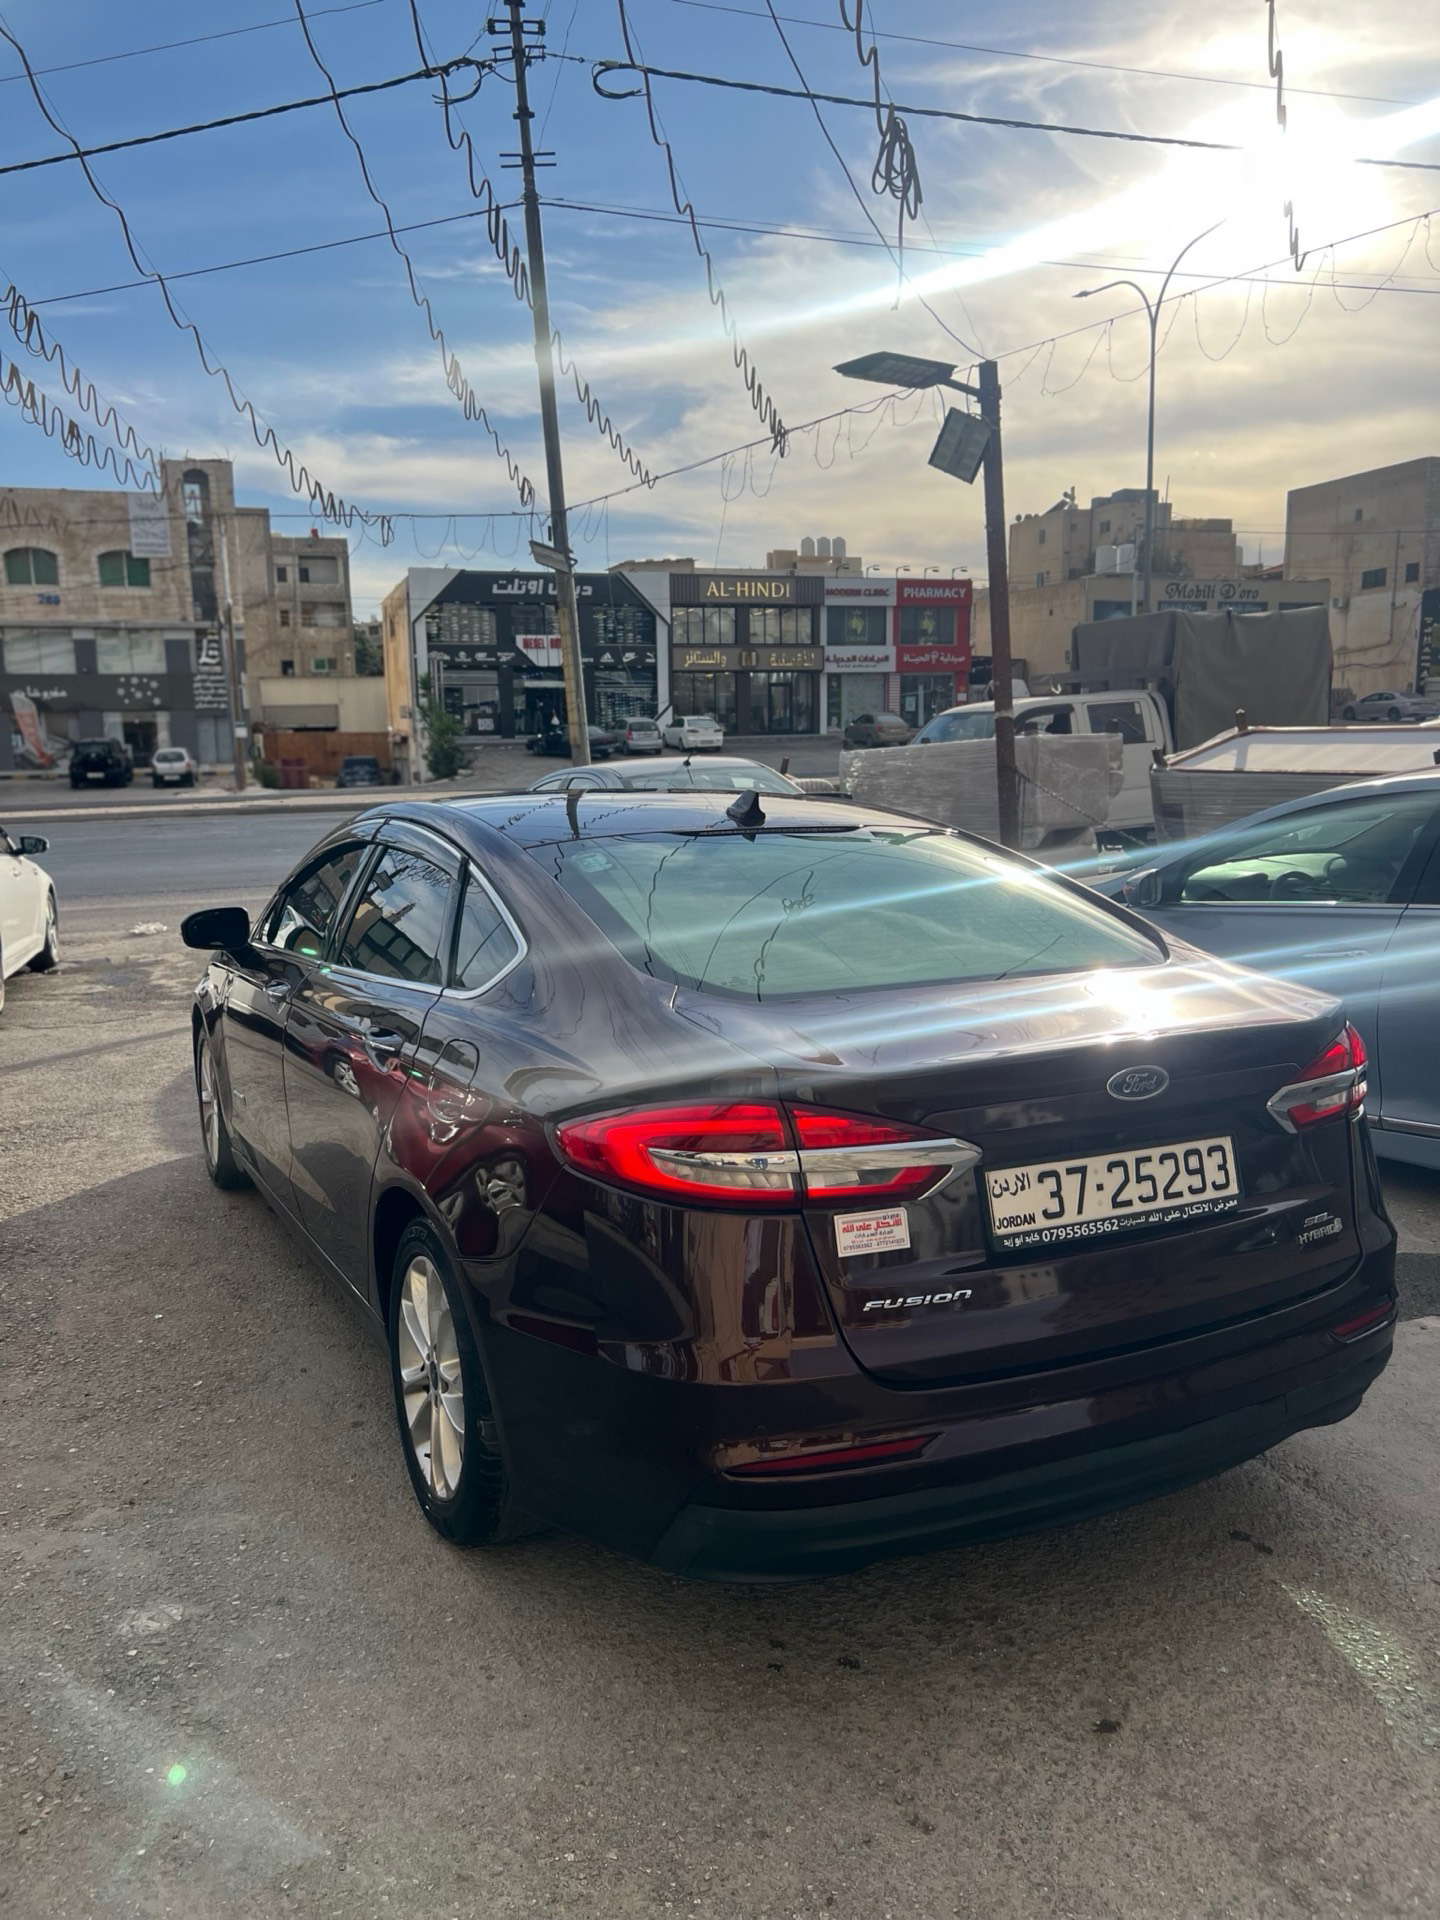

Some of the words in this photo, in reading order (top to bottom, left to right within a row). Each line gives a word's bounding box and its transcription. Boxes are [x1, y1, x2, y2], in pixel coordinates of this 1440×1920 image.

[706, 581, 790, 598] AL-HINDI
[903, 587, 967, 599] PHARMACY
[1165, 582, 1216, 600] Mobili
[684, 650, 727, 668] والستائر
[903, 653, 930, 664] الحياة
[940, 652, 965, 664] صيدلية
[1122, 1072, 1157, 1093] Ford
[1214, 1199, 1238, 1213] معرض
[996, 1212, 1036, 1231] JORDAN
[1148, 1212, 1163, 1223] الله
[1164, 1209, 1181, 1222] على
[1041, 1219, 1119, 1242] 0795565562
[1297, 1223, 1337, 1246] HYBRID
[863, 1289, 973, 1312] FUSION
